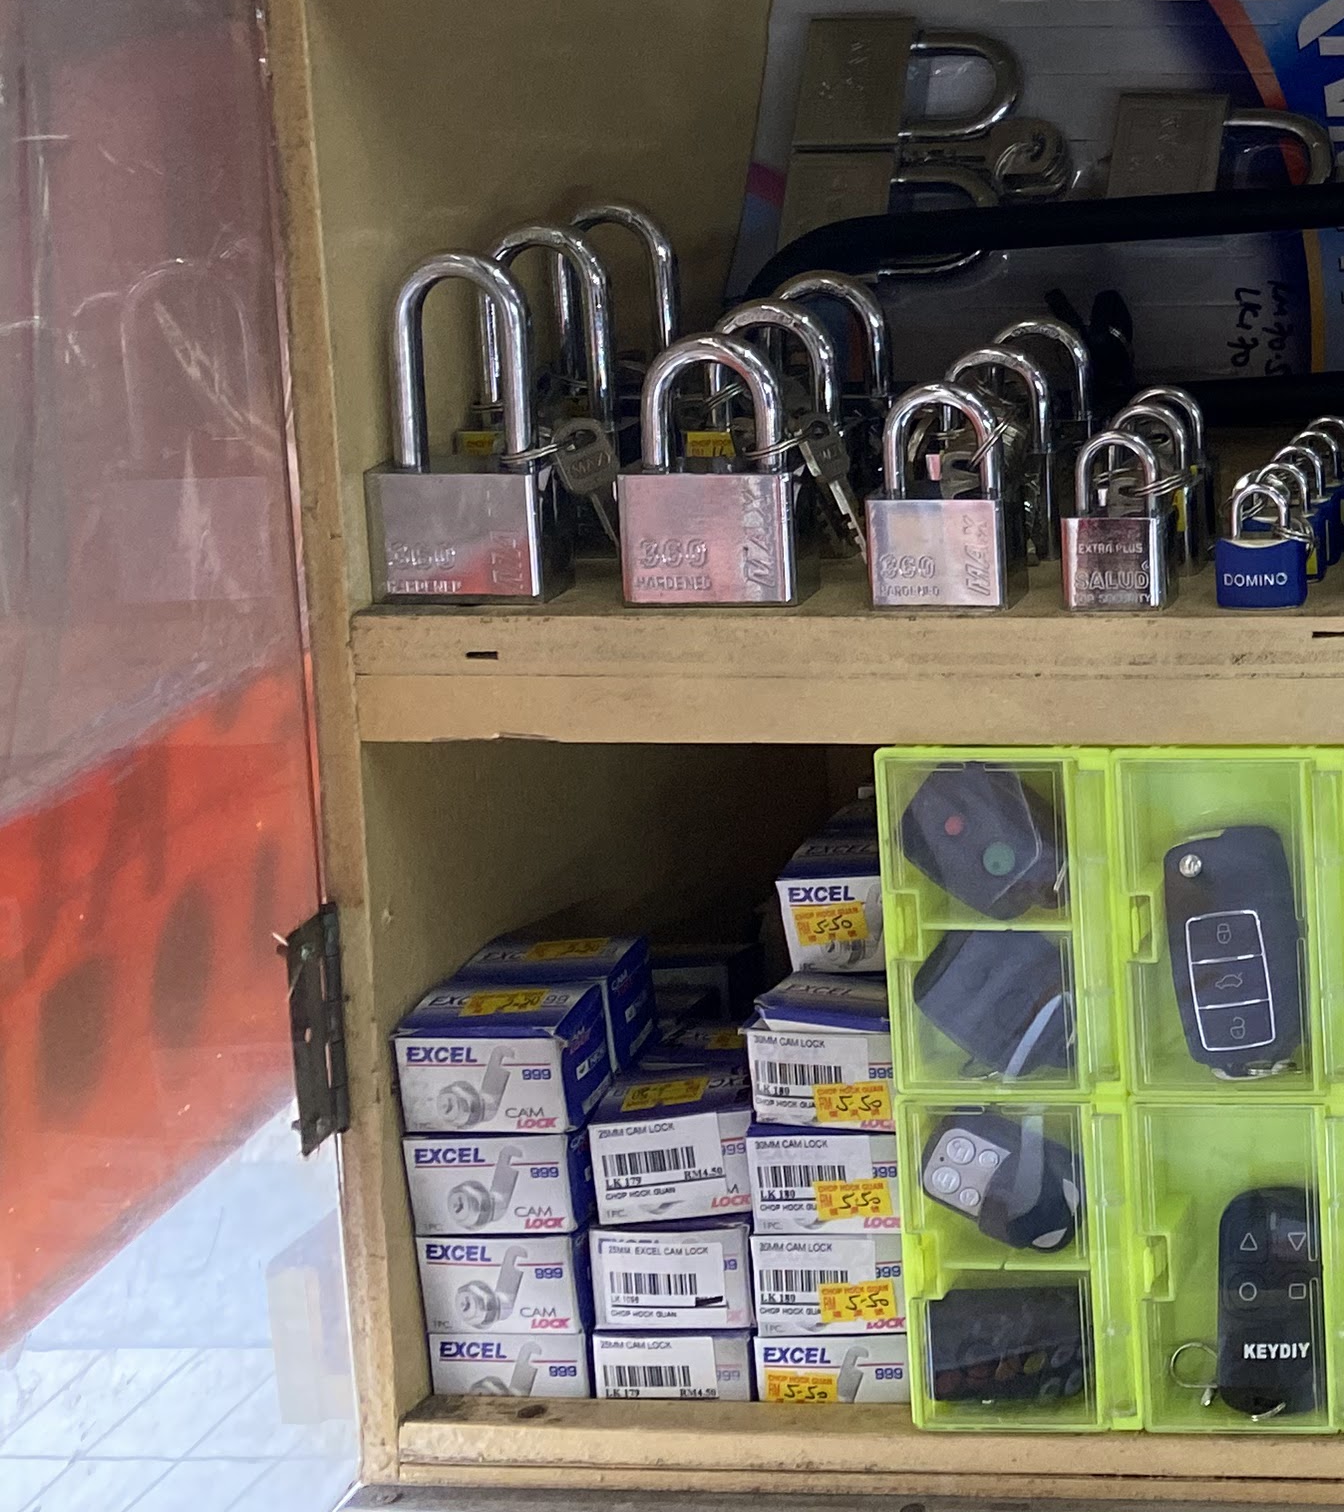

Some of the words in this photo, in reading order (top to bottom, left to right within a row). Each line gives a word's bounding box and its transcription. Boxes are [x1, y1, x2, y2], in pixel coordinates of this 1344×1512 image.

[1079, 543, 1112, 553] EXTRA
[1116, 543, 1143, 553] PLUS
[1075, 571, 1149, 589] SALUD
[1224, 572, 1288, 587] DOMINO
[789, 886, 855, 902] EXCEL
[779, 1039, 800, 1048] CAM
[802, 1039, 825, 1048] LOCK
[406, 1047, 477, 1062] EXCEL
[522, 1068, 552, 1080] 999
[505, 1108, 544, 1118] CAM
[516, 1118, 558, 1129] LOCK
[626, 1126, 647, 1136] CAM
[649, 1123, 675, 1135] LOCK
[779, 1140, 800, 1149] CAM
[802, 1139, 828, 1148] LOCK
[414, 1148, 486, 1164] EXCEL
[514, 1206, 552, 1217] CAM
[525, 1217, 566, 1229] LOCK
[635, 1246, 662, 1255] EXCEL
[685, 1246, 708, 1255] LOCK
[785, 1243, 806, 1252] CAM
[808, 1242, 832, 1252] LOCK
[426, 1244, 491, 1262] EXCEL
[520, 1308, 556, 1318] CAM
[531, 1318, 570, 1329] LOCK
[440, 1342, 506, 1358] EXCEL
[650, 1341, 672, 1349] LOCK
[764, 1347, 831, 1364] EXCEL
[1243, 1342, 1310, 1360] KEYDIY
[875, 1368, 903, 1379] 999
